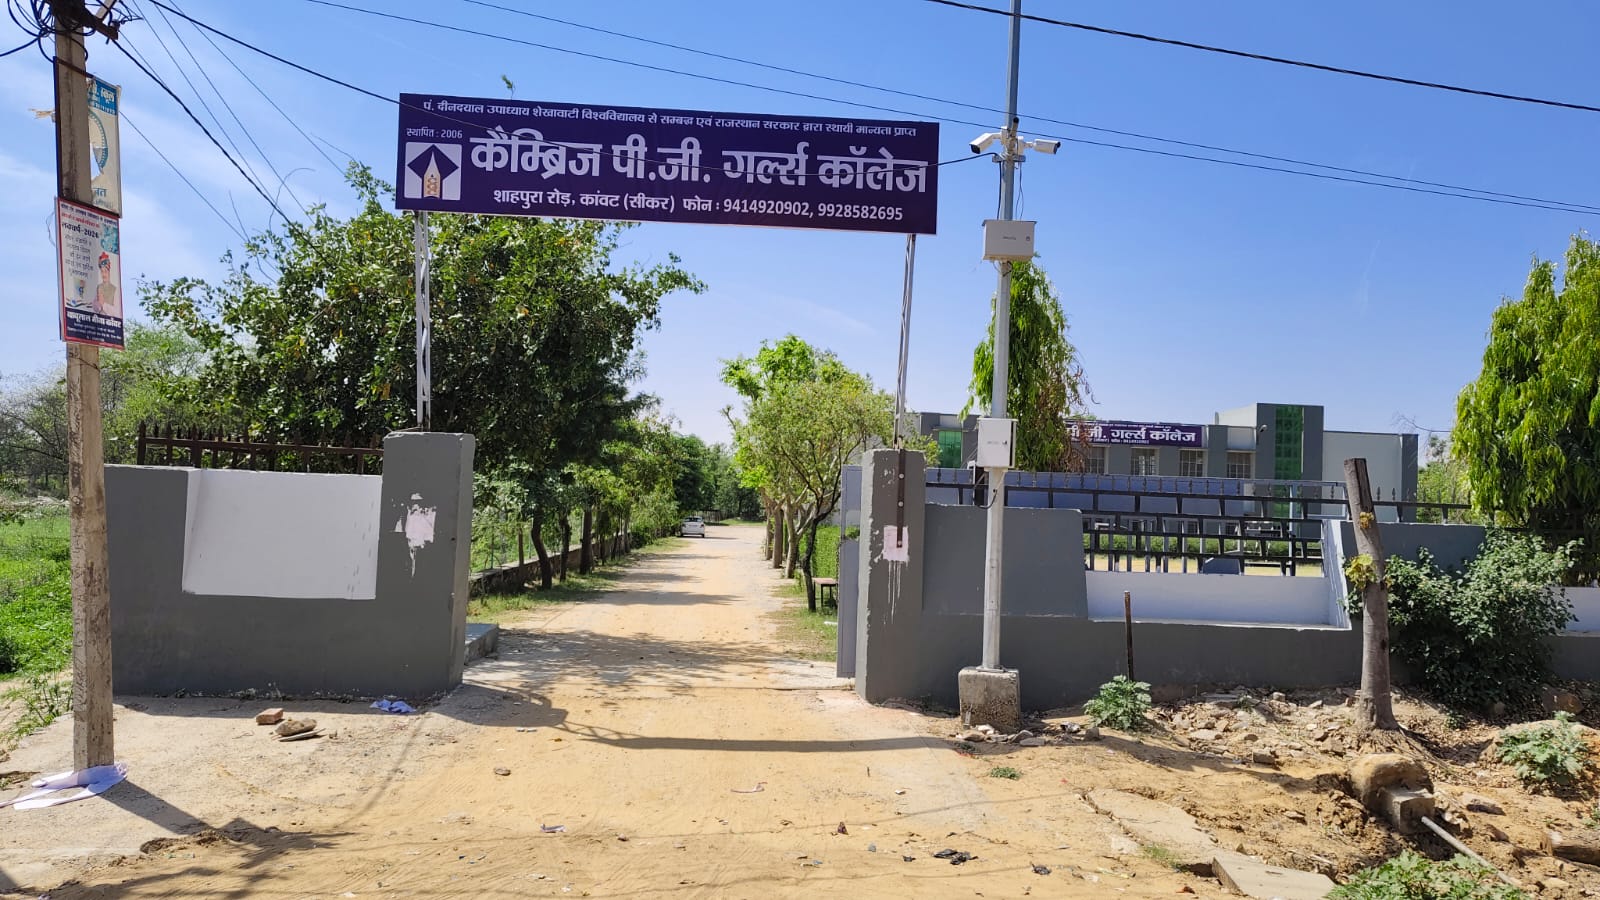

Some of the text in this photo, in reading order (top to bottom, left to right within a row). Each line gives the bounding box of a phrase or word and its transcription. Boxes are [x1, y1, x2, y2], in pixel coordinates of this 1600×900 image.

[406, 126, 434, 138] स्थापित
[440, 129, 463, 139] 2006
[423, 99, 435, 111] पं.
[437, 100, 484, 114] दीनदयाल
[486, 104, 530, 117] उपाध्याय
[532, 105, 579, 119] शेखावाटी
[581, 108, 645, 123] विश्वविद्यालय
[647, 112, 658, 124] से
[696, 115, 713, 127] एवं
[714, 117, 760, 129] राजस्थान
[762, 119, 801, 131] सरकार
[802, 121, 823, 132] द्वारा
[825, 121, 853, 134] स्थायी
[855, 124, 892, 136] मान्यता
[893, 126, 917, 137] प्राप्त
[469, 124, 604, 180] कैम्ब्रिज
[721, 141, 810, 187] गर्ल्स
[816, 144, 929, 193] कॉलेज
[493, 189, 543, 209] शाहपुरा
[579, 190, 621, 207] कांवट
[623, 192, 676, 213] (सीकर)
[683, 195, 712, 212] फोन
[723, 198, 814, 219] 9414920902,
[817, 203, 904, 221] 9928582695
[1111, 427, 1147, 440] गर्ल्स
[1149, 428, 1197, 442] कॉलेज
